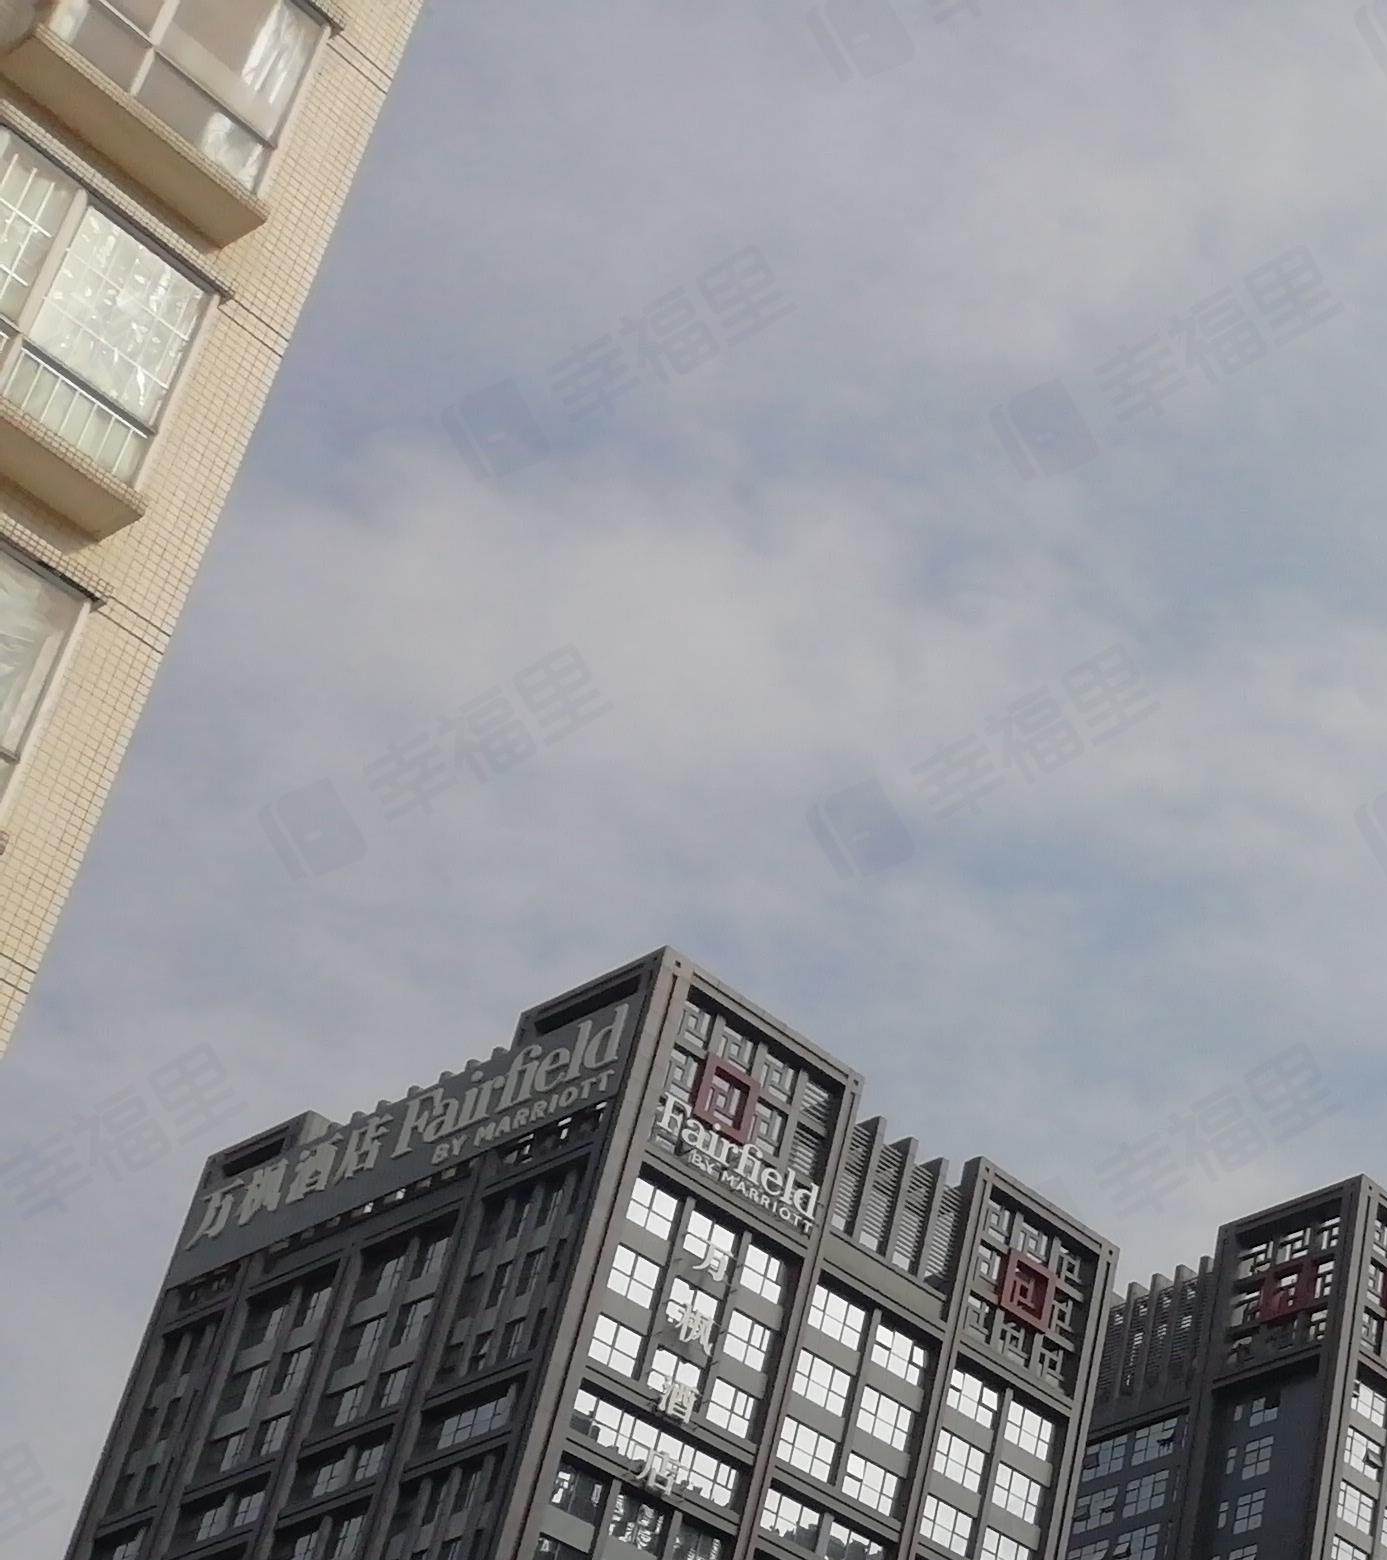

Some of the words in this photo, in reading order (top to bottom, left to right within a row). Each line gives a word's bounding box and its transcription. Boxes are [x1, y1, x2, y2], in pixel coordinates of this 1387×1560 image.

[391, 1003, 629, 1160] Fairfield
[432, 1134, 467, 1166] BY
[474, 1069, 616, 1146] MARRIOTT
[656, 1092, 820, 1220] Fairfield
[689, 1152, 717, 1177] BY
[721, 1170, 813, 1236] MARRIOTT
